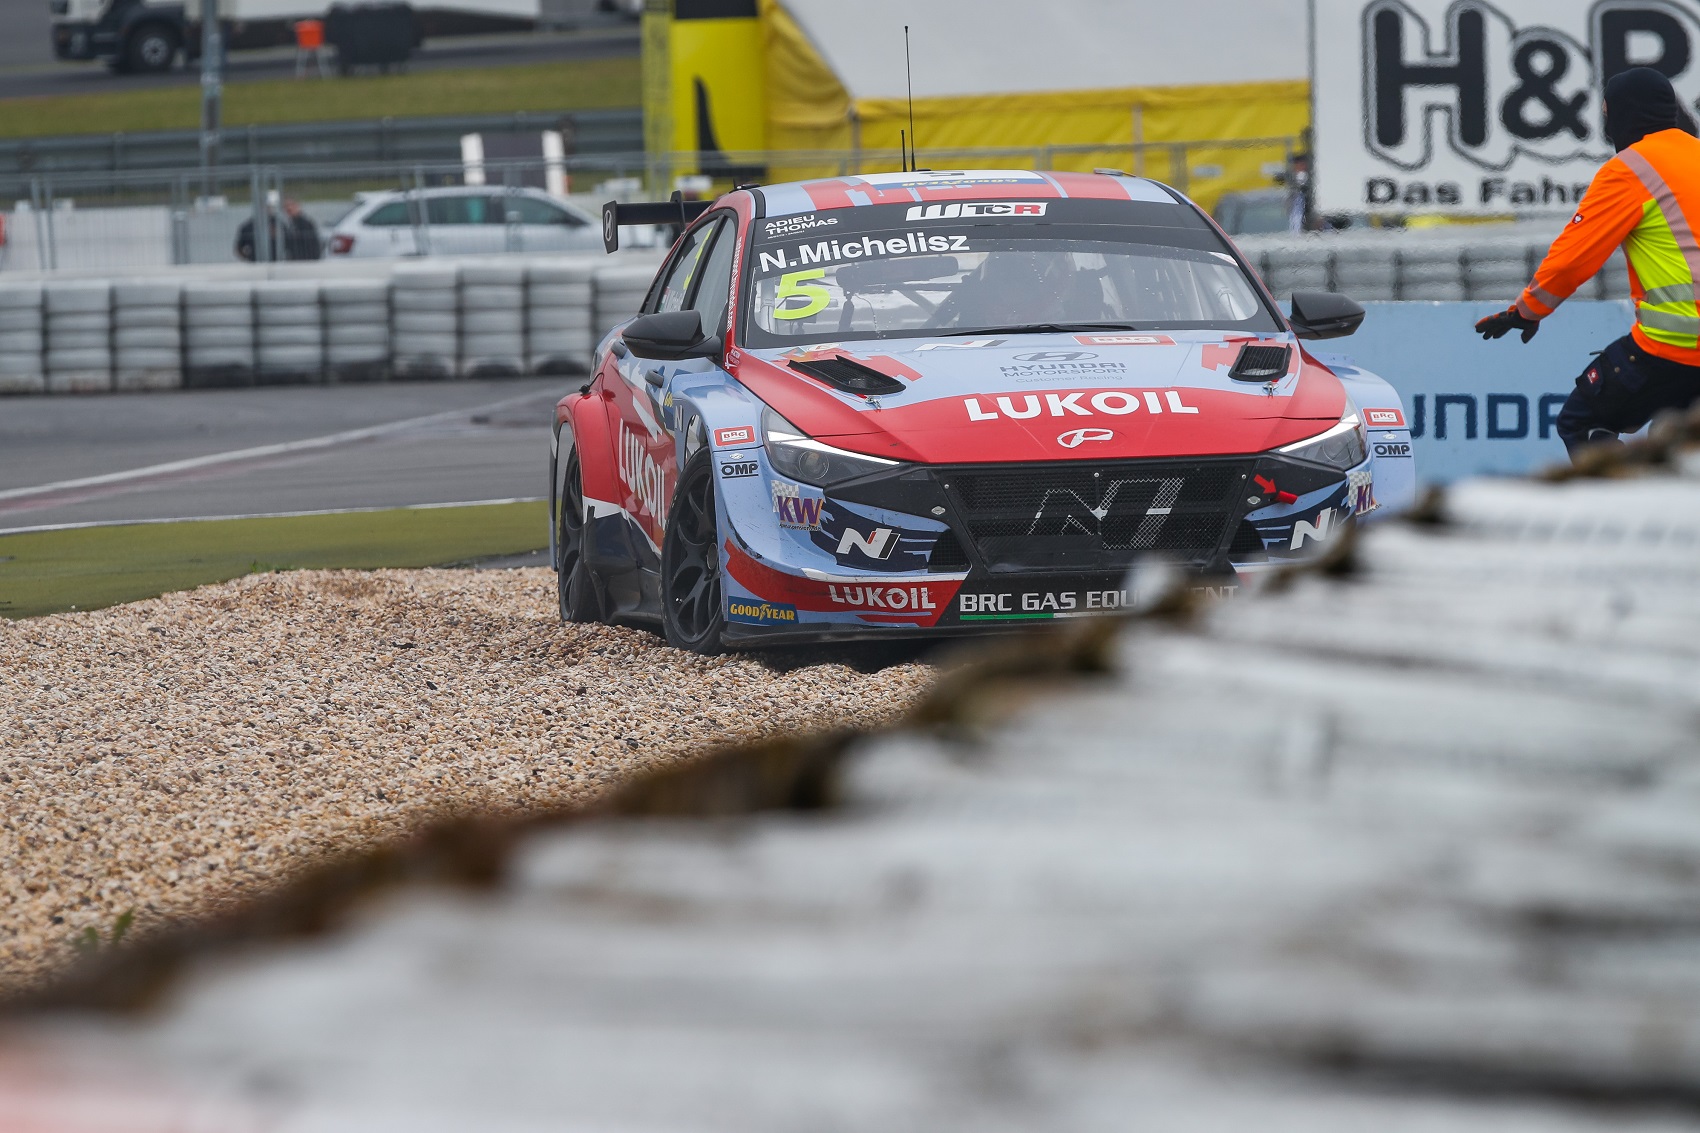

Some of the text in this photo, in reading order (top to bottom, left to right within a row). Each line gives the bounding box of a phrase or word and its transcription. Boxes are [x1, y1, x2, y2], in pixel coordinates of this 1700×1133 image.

[1366, 179, 1461, 204] Das
[906, 202, 1048, 221] WTCR
[765, 214, 815, 229] ADIEU
[766, 218, 838, 235] THOMAS
[759, 232, 969, 272] N.Michelisz
[773, 269, 830, 319] 5
[1000, 362, 1126, 372] HYUNDAI
[1003, 368, 1128, 378] MOTORSPORT
[963, 390, 1199, 421] LUKOIL
[723, 431, 746, 439] BRC
[1374, 445, 1411, 455] OMP
[618, 418, 668, 531] LUKOIL
[721, 463, 758, 476] OMP
[777, 496, 824, 526] KW
[829, 585, 936, 609] LUKOIL
[960, 585, 1238, 612] BRC GAS EQUNT
[730, 603, 795, 621] GOODYEAR
